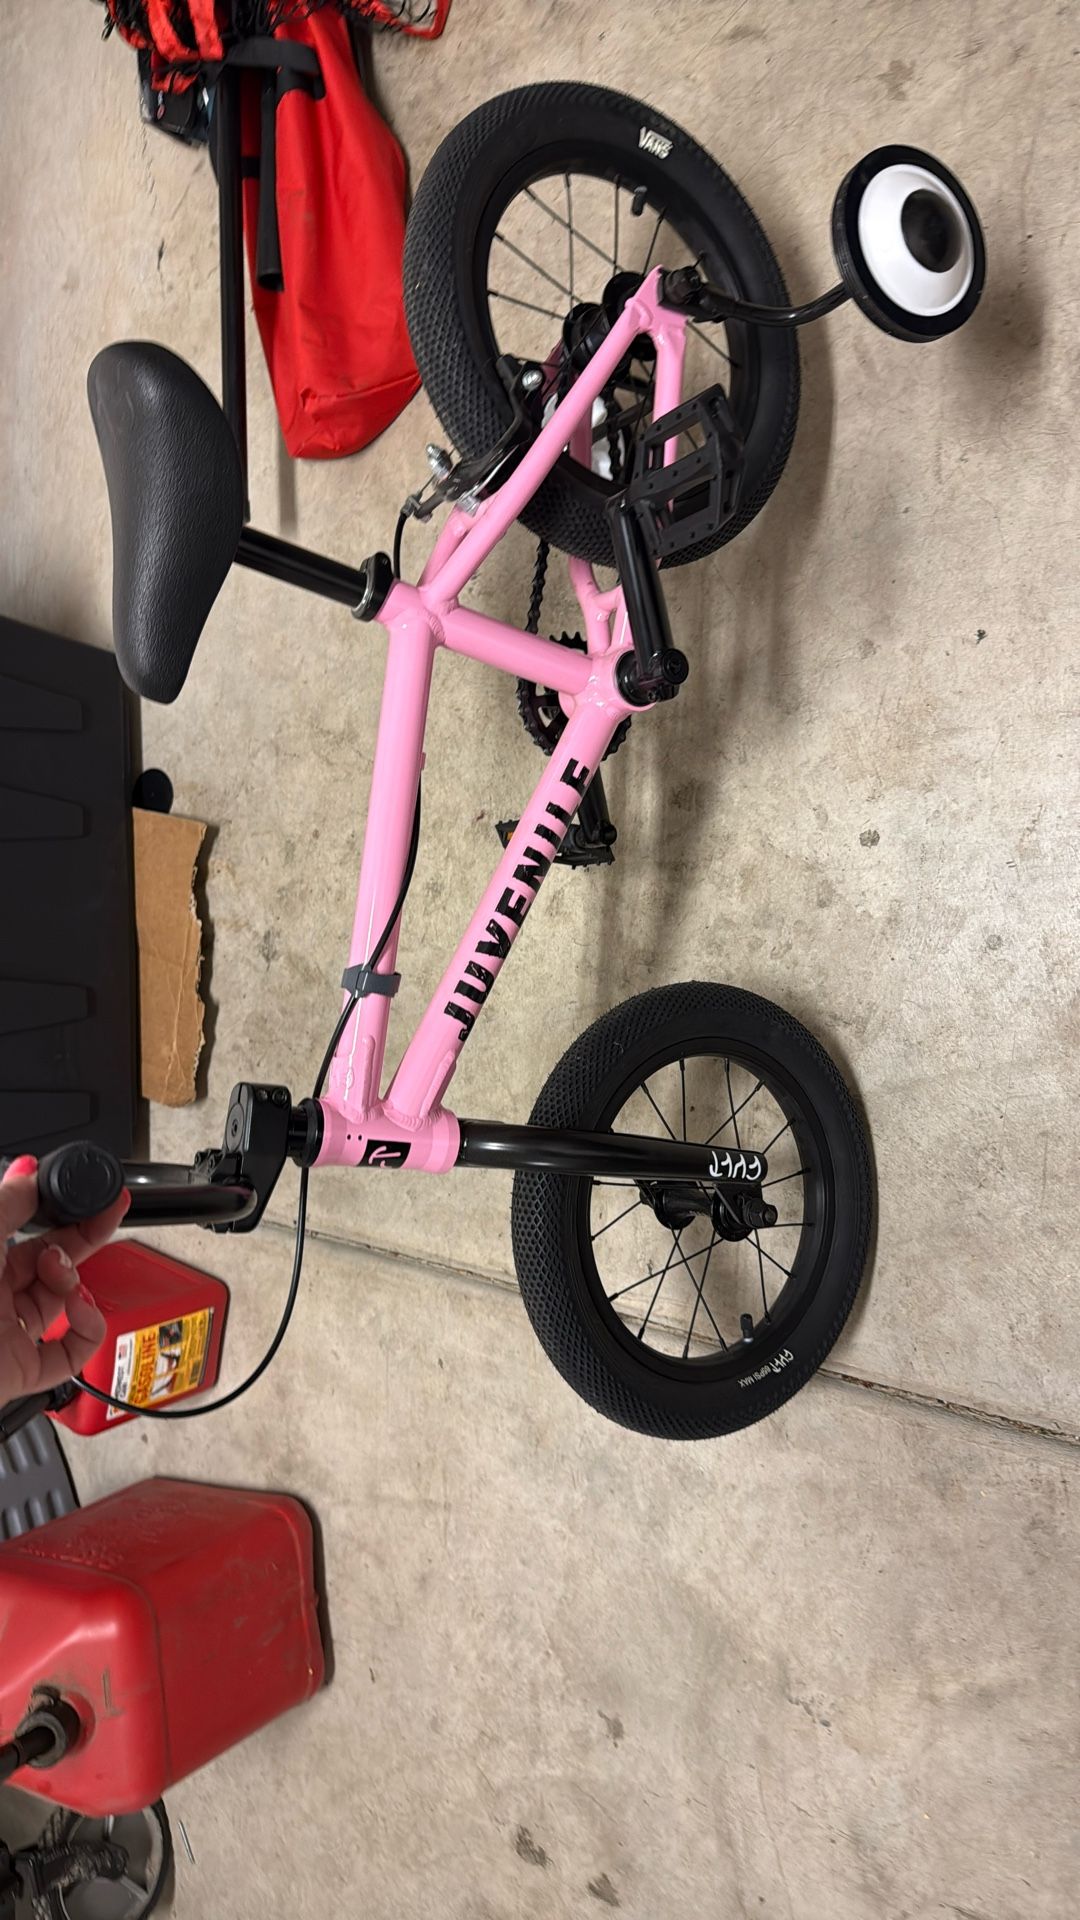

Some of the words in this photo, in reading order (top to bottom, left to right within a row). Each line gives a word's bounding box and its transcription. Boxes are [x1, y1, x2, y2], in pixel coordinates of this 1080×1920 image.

[638, 126, 674, 160] VANS
[709, 1150, 762, 1181] CULT
[133, 1331, 156, 1404] GASOLINE
[769, 1348, 794, 1373] CULT
[737, 1376, 755, 1388] MAX
